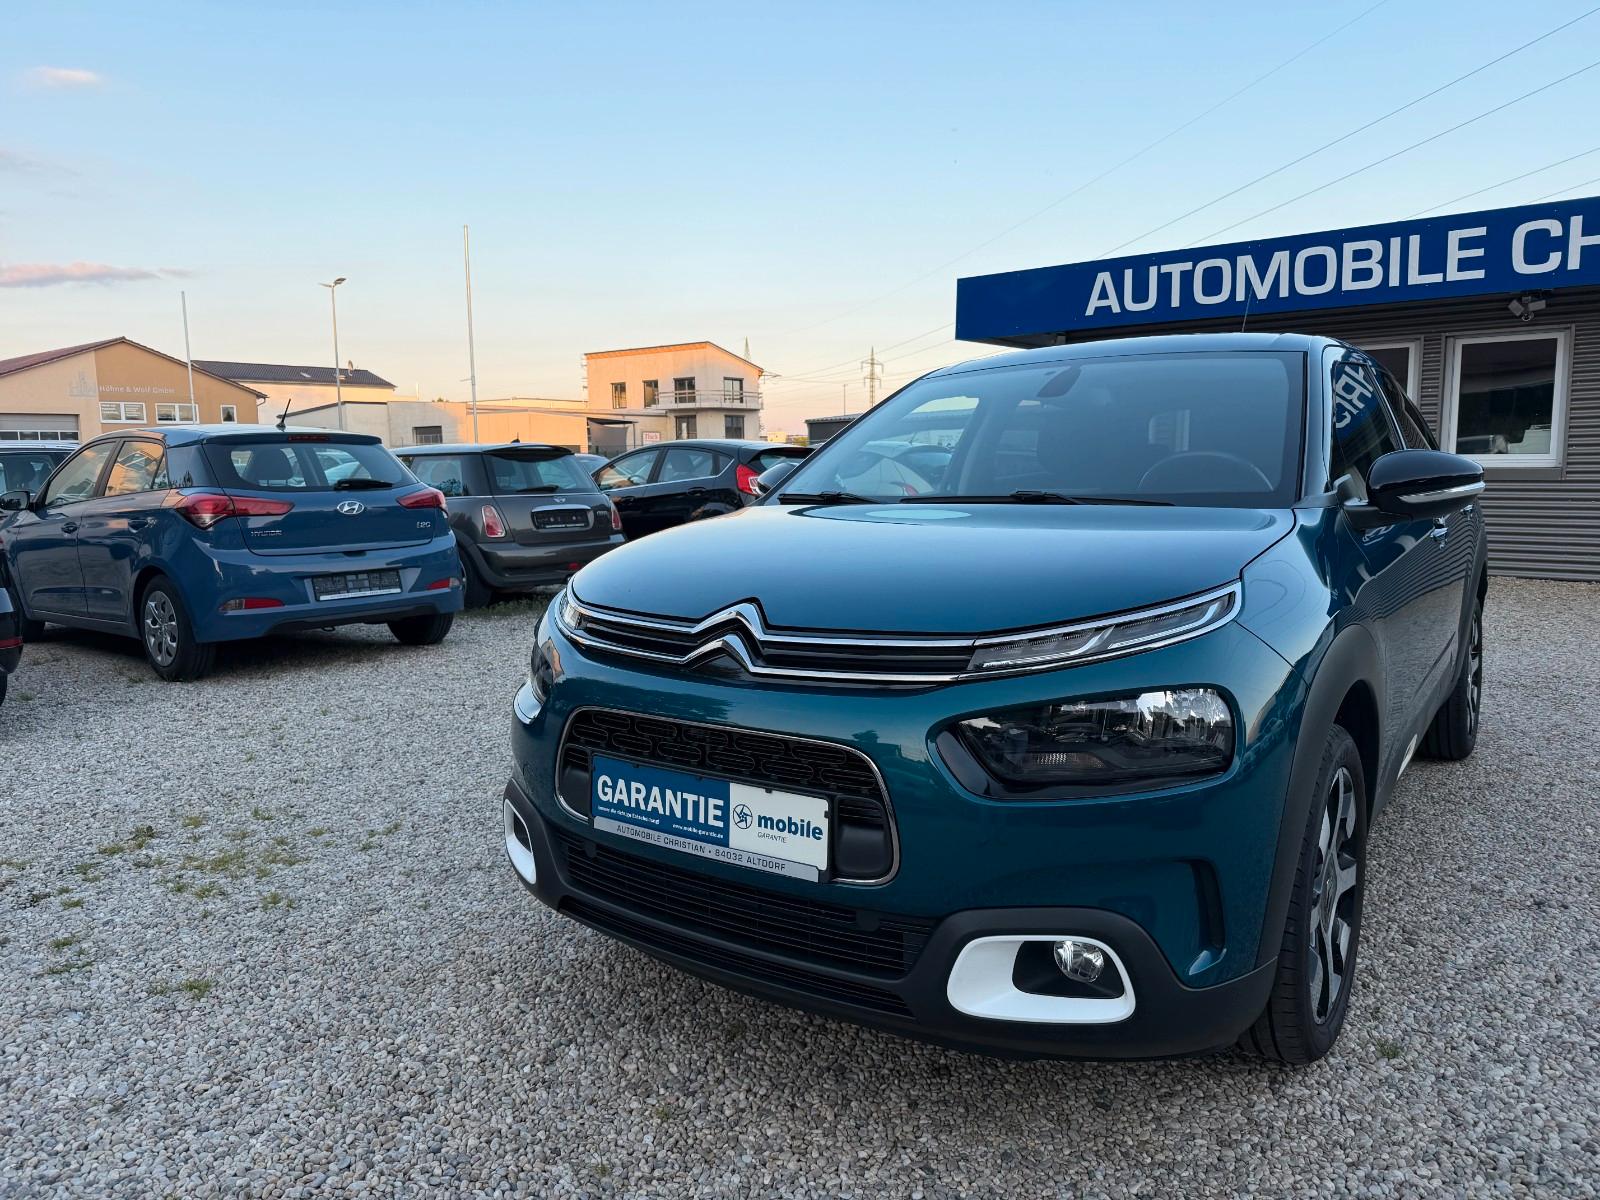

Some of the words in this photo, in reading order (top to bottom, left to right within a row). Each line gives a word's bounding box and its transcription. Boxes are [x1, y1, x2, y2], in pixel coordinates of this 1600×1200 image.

[1085, 226, 1487, 317] AUTOMOBILE
[597, 774, 724, 828] GARANTIE
[616, 824, 662, 843] AUTOMOBILE
[663, 831, 706, 854] CHRISTIAN
[715, 848, 743, 863] 84032
[746, 855, 786, 872] ALTDORF
[757, 813, 824, 841] mobile
[757, 831, 788, 844] GARANTIE
